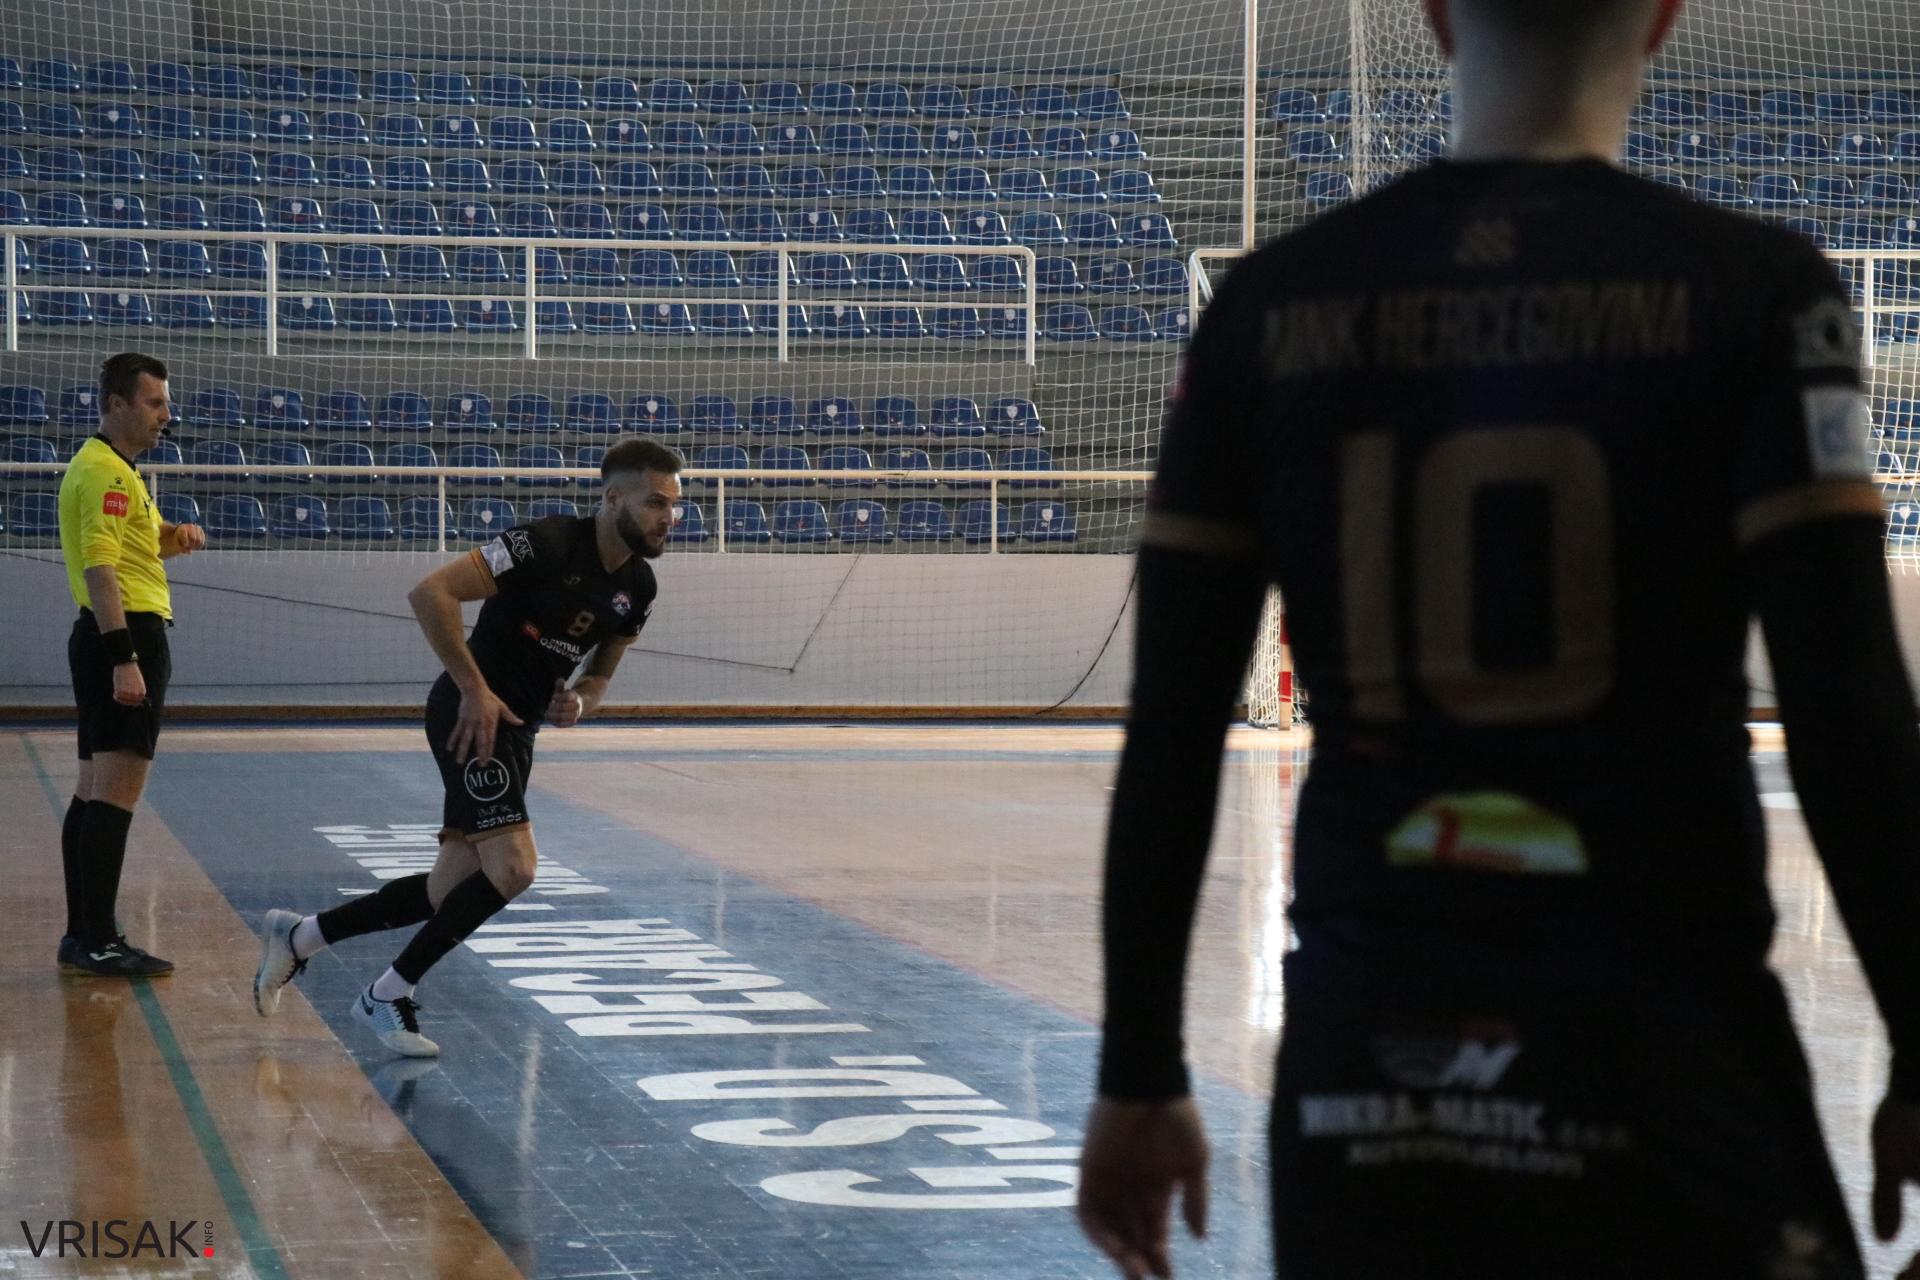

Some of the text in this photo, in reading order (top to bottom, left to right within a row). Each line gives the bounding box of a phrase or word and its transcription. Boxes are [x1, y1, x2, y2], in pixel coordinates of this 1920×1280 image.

[1340, 426, 1616, 726] 10
[567, 609, 595, 637] 8
[469, 768, 504, 790] MCI
[463, 917, 872, 1037] PECARA
